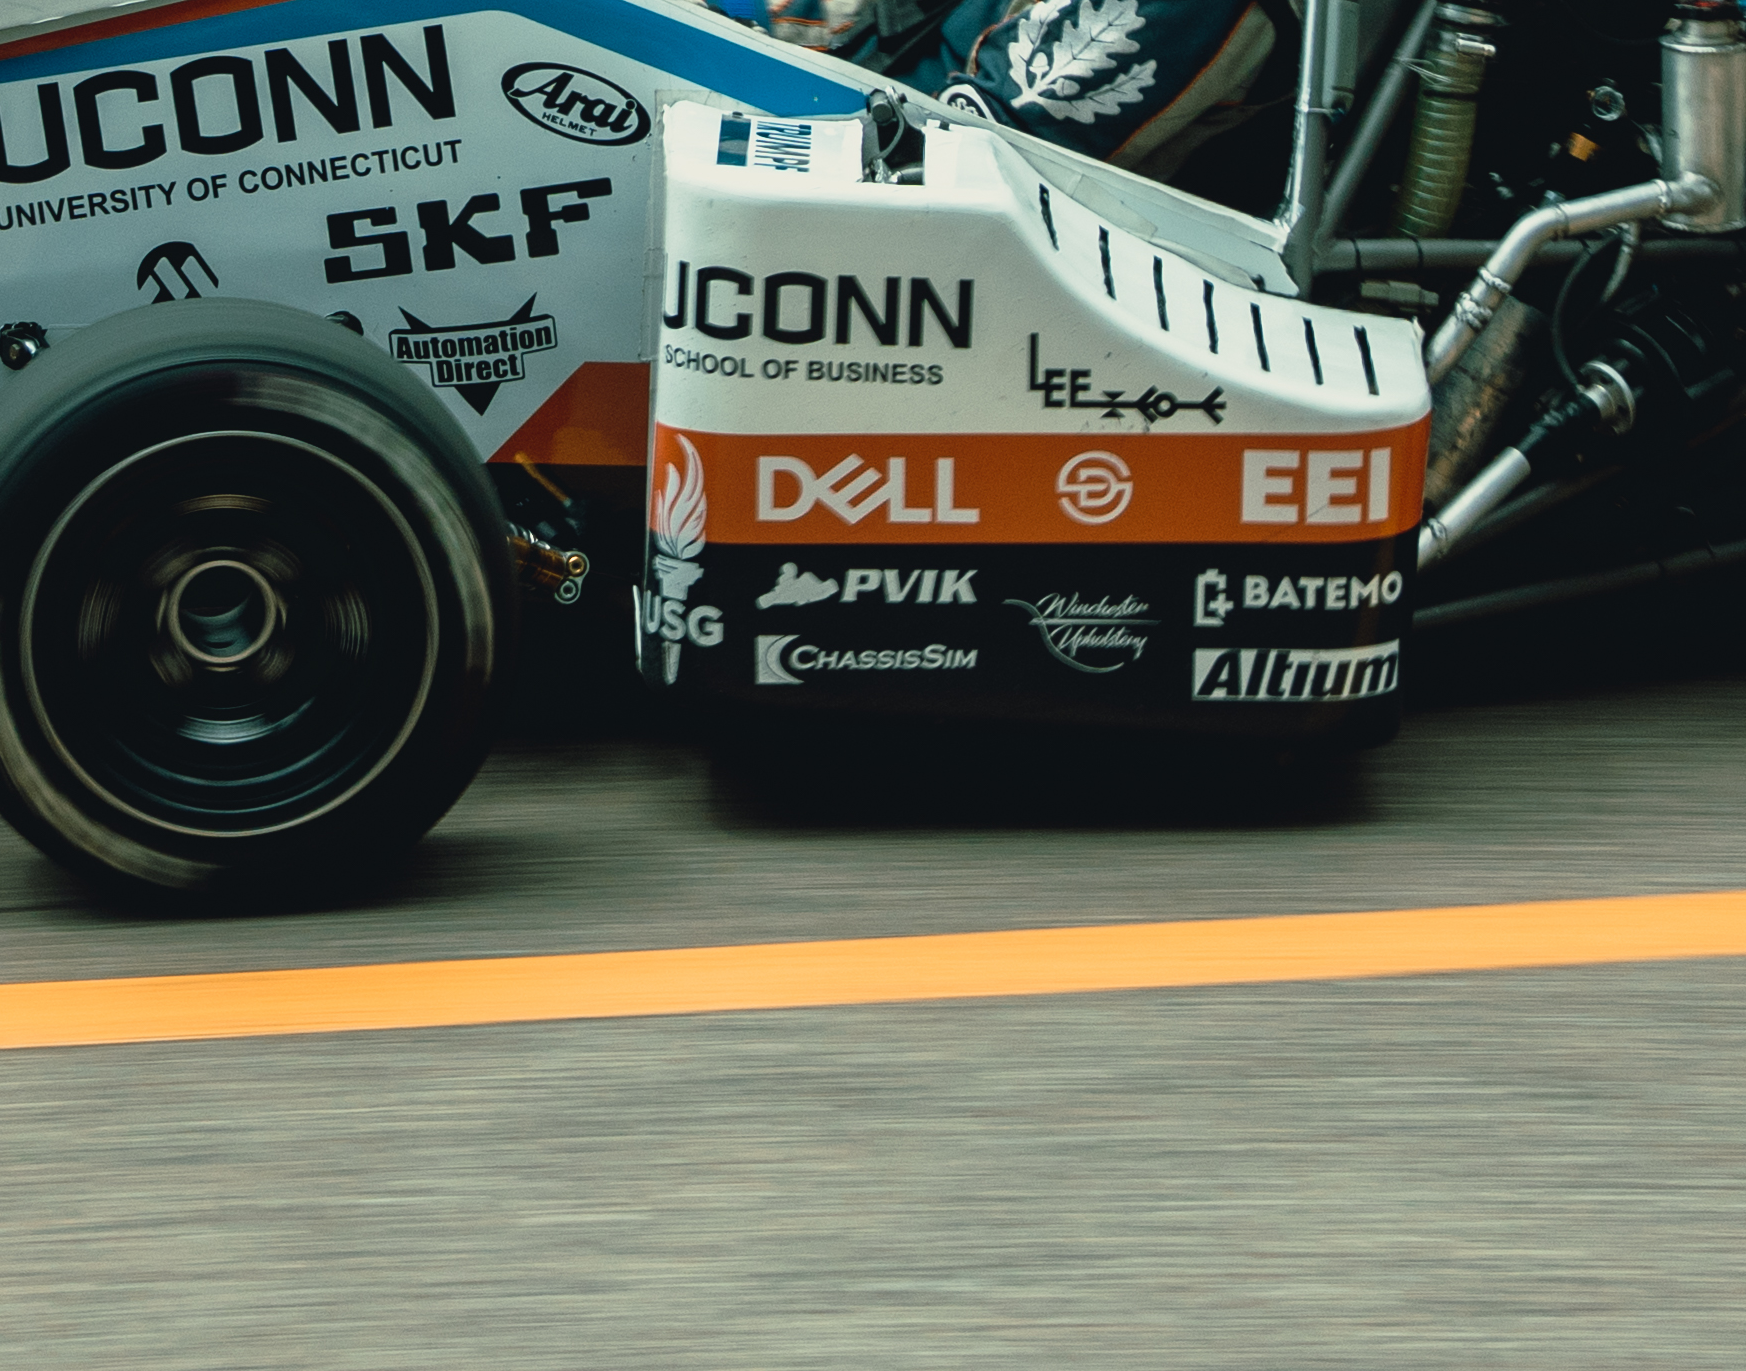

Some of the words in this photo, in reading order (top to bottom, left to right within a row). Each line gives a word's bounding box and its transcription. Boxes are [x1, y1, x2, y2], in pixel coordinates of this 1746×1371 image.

[507, 71, 637, 134] Arai
[541, 111, 598, 137] HELMET
[754, 120, 812, 173] TRUMPF
[186, 175, 228, 203] OF
[237, 139, 464, 196] CONNECTICUT
[324, 177, 613, 285] SKF
[395, 321, 553, 361] Automation
[665, 343, 755, 379] SCHOOL
[763, 358, 799, 381] OF
[807, 359, 944, 386] BUSINESS
[435, 352, 523, 384] Direct
[755, 453, 981, 525] DELL
[1239, 446, 1392, 526] EEI
[839, 568, 979, 605] PVIK
[1036, 591, 1150, 619] Winchester
[1242, 570, 1403, 612] BATEMO
[642, 589, 724, 647] USG
[1050, 623, 1149, 661] Upholstery
[1195, 643, 1400, 699] Altium
